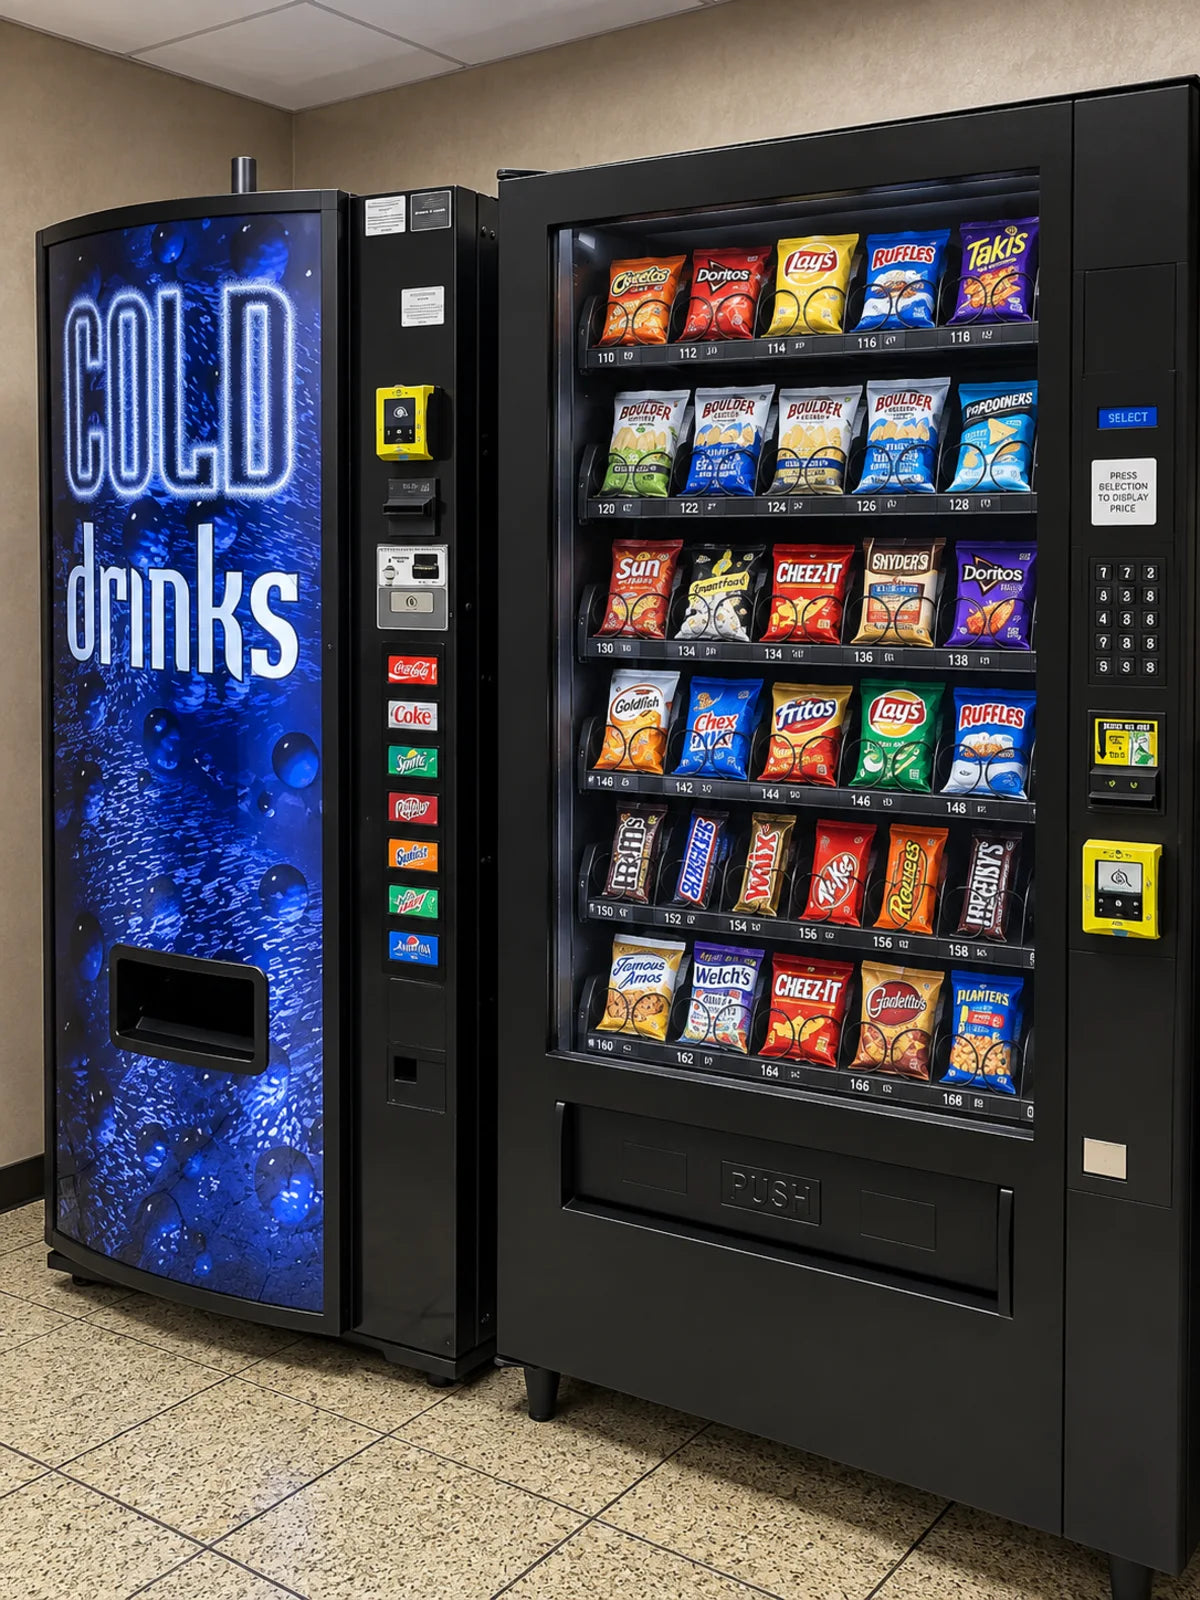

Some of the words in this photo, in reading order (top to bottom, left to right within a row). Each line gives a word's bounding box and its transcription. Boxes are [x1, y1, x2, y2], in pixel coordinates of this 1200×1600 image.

[967, 226, 1029, 271] Takis
[872, 245, 936, 271] RUFFLES
[697, 268, 749, 283] Doritos
[858, 337, 876, 348] 116
[951, 331, 970, 343] 118
[680, 348, 697, 359] 112
[768, 343, 786, 354] 114
[598, 353, 614, 363] 110
[65, 283, 297, 498] COLD
[702, 397, 756, 419] BOULDER
[875, 391, 932, 413] BOULDER
[619, 402, 672, 421] BOULDER
[787, 400, 842, 419] BOULDER
[1108, 412, 1148, 423] SELECT
[1110, 472, 1137, 480] PRESS
[1099, 482, 1148, 491] SELECTION
[1098, 493, 1110, 502] TO
[1112, 493, 1149, 502] DISPLAY
[598, 503, 615, 514] 120
[681, 502, 699, 513] 122
[768, 502, 786, 512] 124
[857, 501, 876, 512] 126
[950, 499, 969, 510] 128
[1110, 504, 1136, 512] PRICE
[616, 557, 661, 580] Sun
[963, 563, 1023, 582] Doritos
[66, 522, 299, 683] drinks
[597, 643, 613, 654] 130
[678, 646, 695, 657] 134
[765, 649, 782, 660] 134
[854, 651, 873, 663] 136
[948, 654, 968, 666] 138
[394, 705, 431, 725] Coke
[776, 698, 836, 728] Fritos
[959, 703, 1025, 730] RUFFLES
[694, 712, 738, 732] Chex
[676, 782, 693, 793] 142
[762, 788, 779, 799] 144
[851, 795, 870, 806] 146
[947, 802, 966, 813] 148
[597, 905, 613, 916] 150
[665, 913, 681, 924] 152
[729, 920, 747, 931] 154
[799, 927, 817, 939] 156
[874, 937, 892, 948] 156
[949, 944, 968, 957] 158
[618, 971, 663, 990] Amos
[696, 966, 751, 986] Welch's
[596, 1040, 613, 1051] 160
[677, 1052, 694, 1064] 162
[761, 1065, 778, 1077] 164
[850, 1079, 869, 1091] 166
[943, 1094, 963, 1106] 168
[730, 1171, 812, 1216] PUSH
